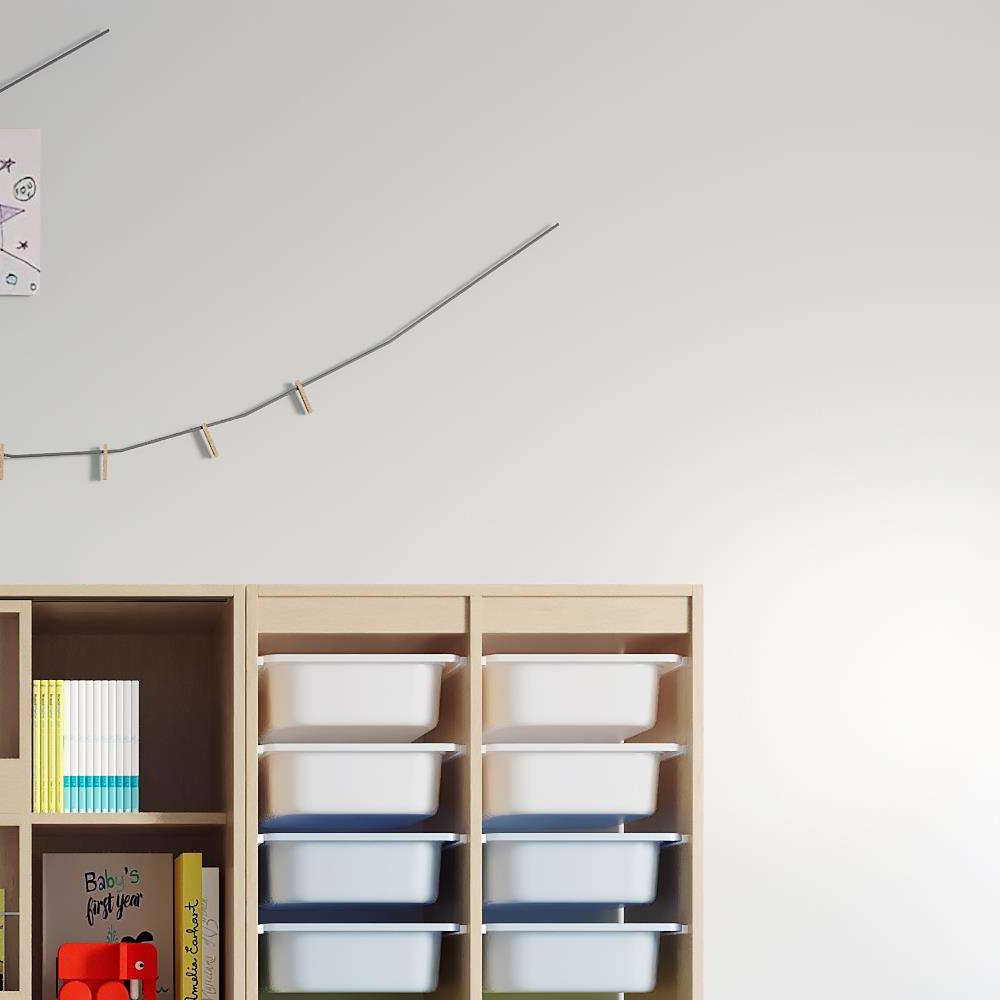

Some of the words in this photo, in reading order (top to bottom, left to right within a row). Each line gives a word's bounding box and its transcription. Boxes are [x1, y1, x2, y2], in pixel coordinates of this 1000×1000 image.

[84, 867, 141, 893] Baby's
[86, 893, 114, 926] first
[116, 892, 143, 920] year
[184, 899, 199, 954] Earhart
